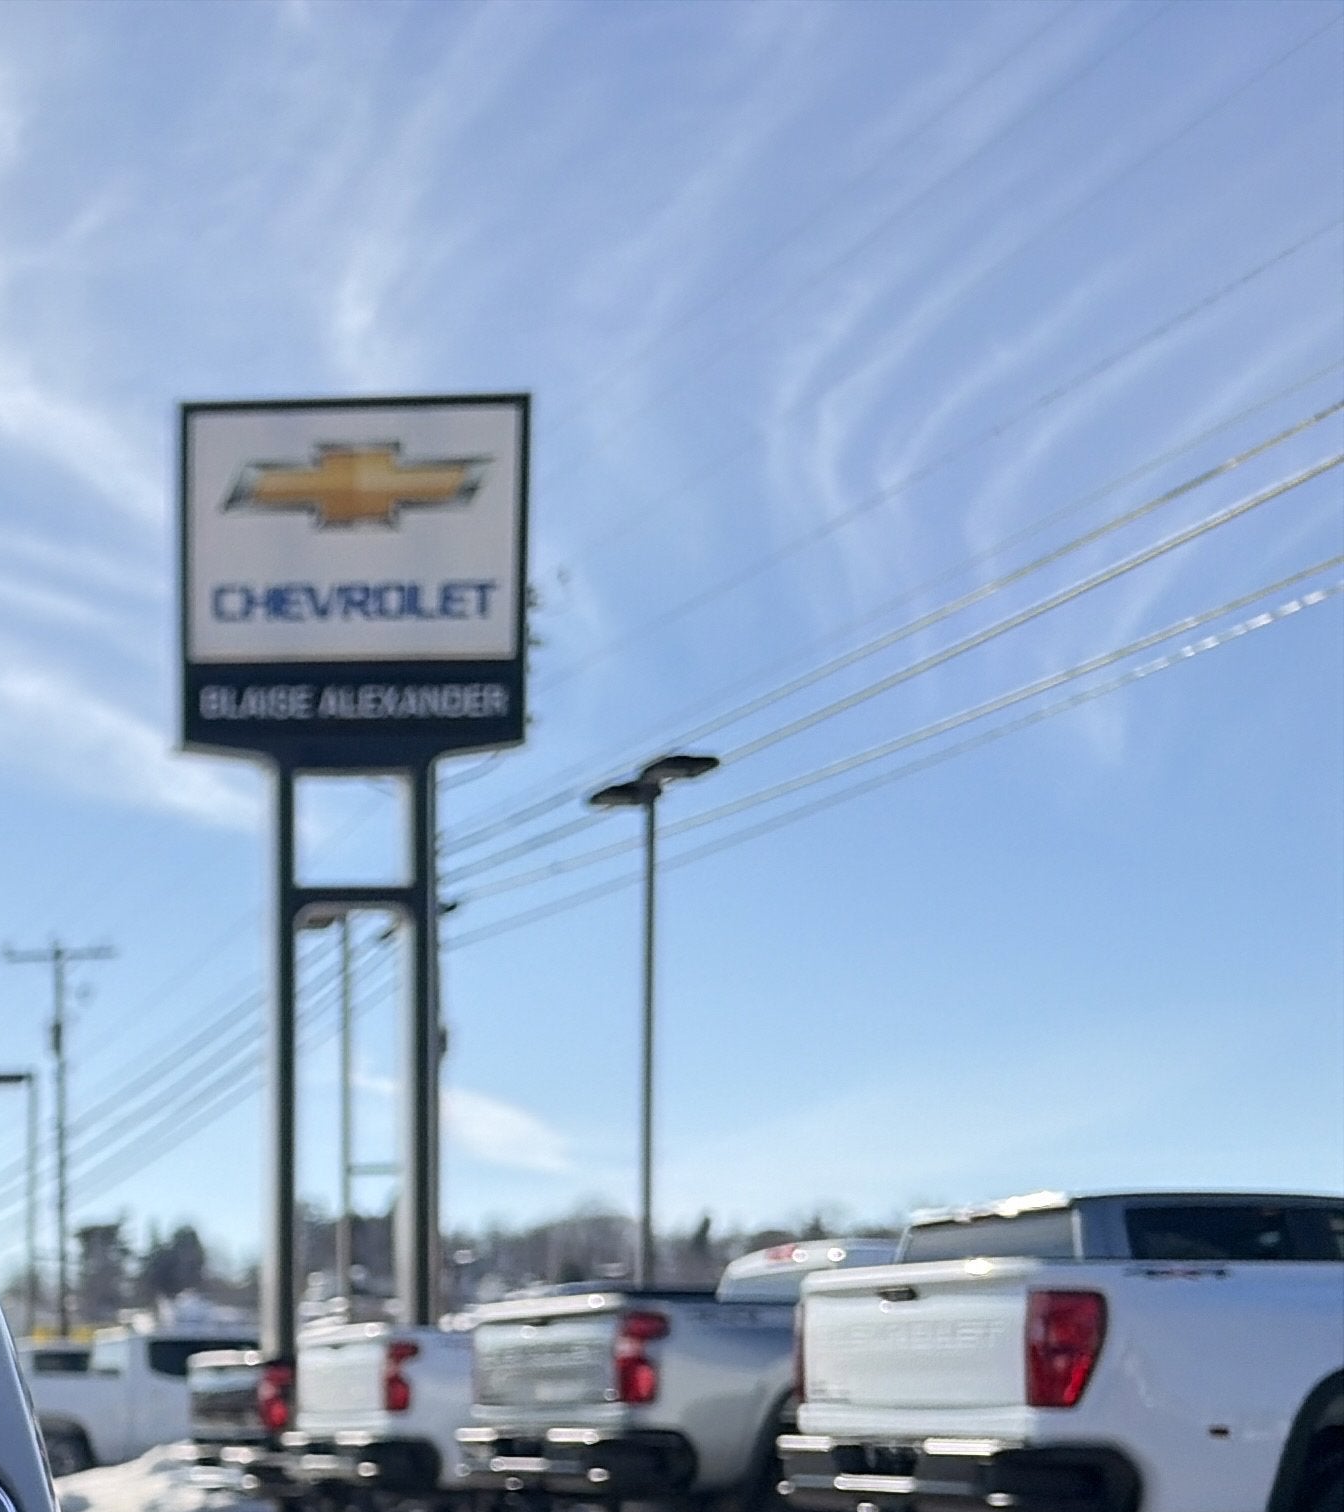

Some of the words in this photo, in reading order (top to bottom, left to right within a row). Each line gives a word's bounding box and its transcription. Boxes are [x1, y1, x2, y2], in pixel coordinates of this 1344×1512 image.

[212, 578, 496, 623] CHEVROLET
[198, 684, 312, 721] BLAISE
[317, 683, 509, 719] ALEXANDER
